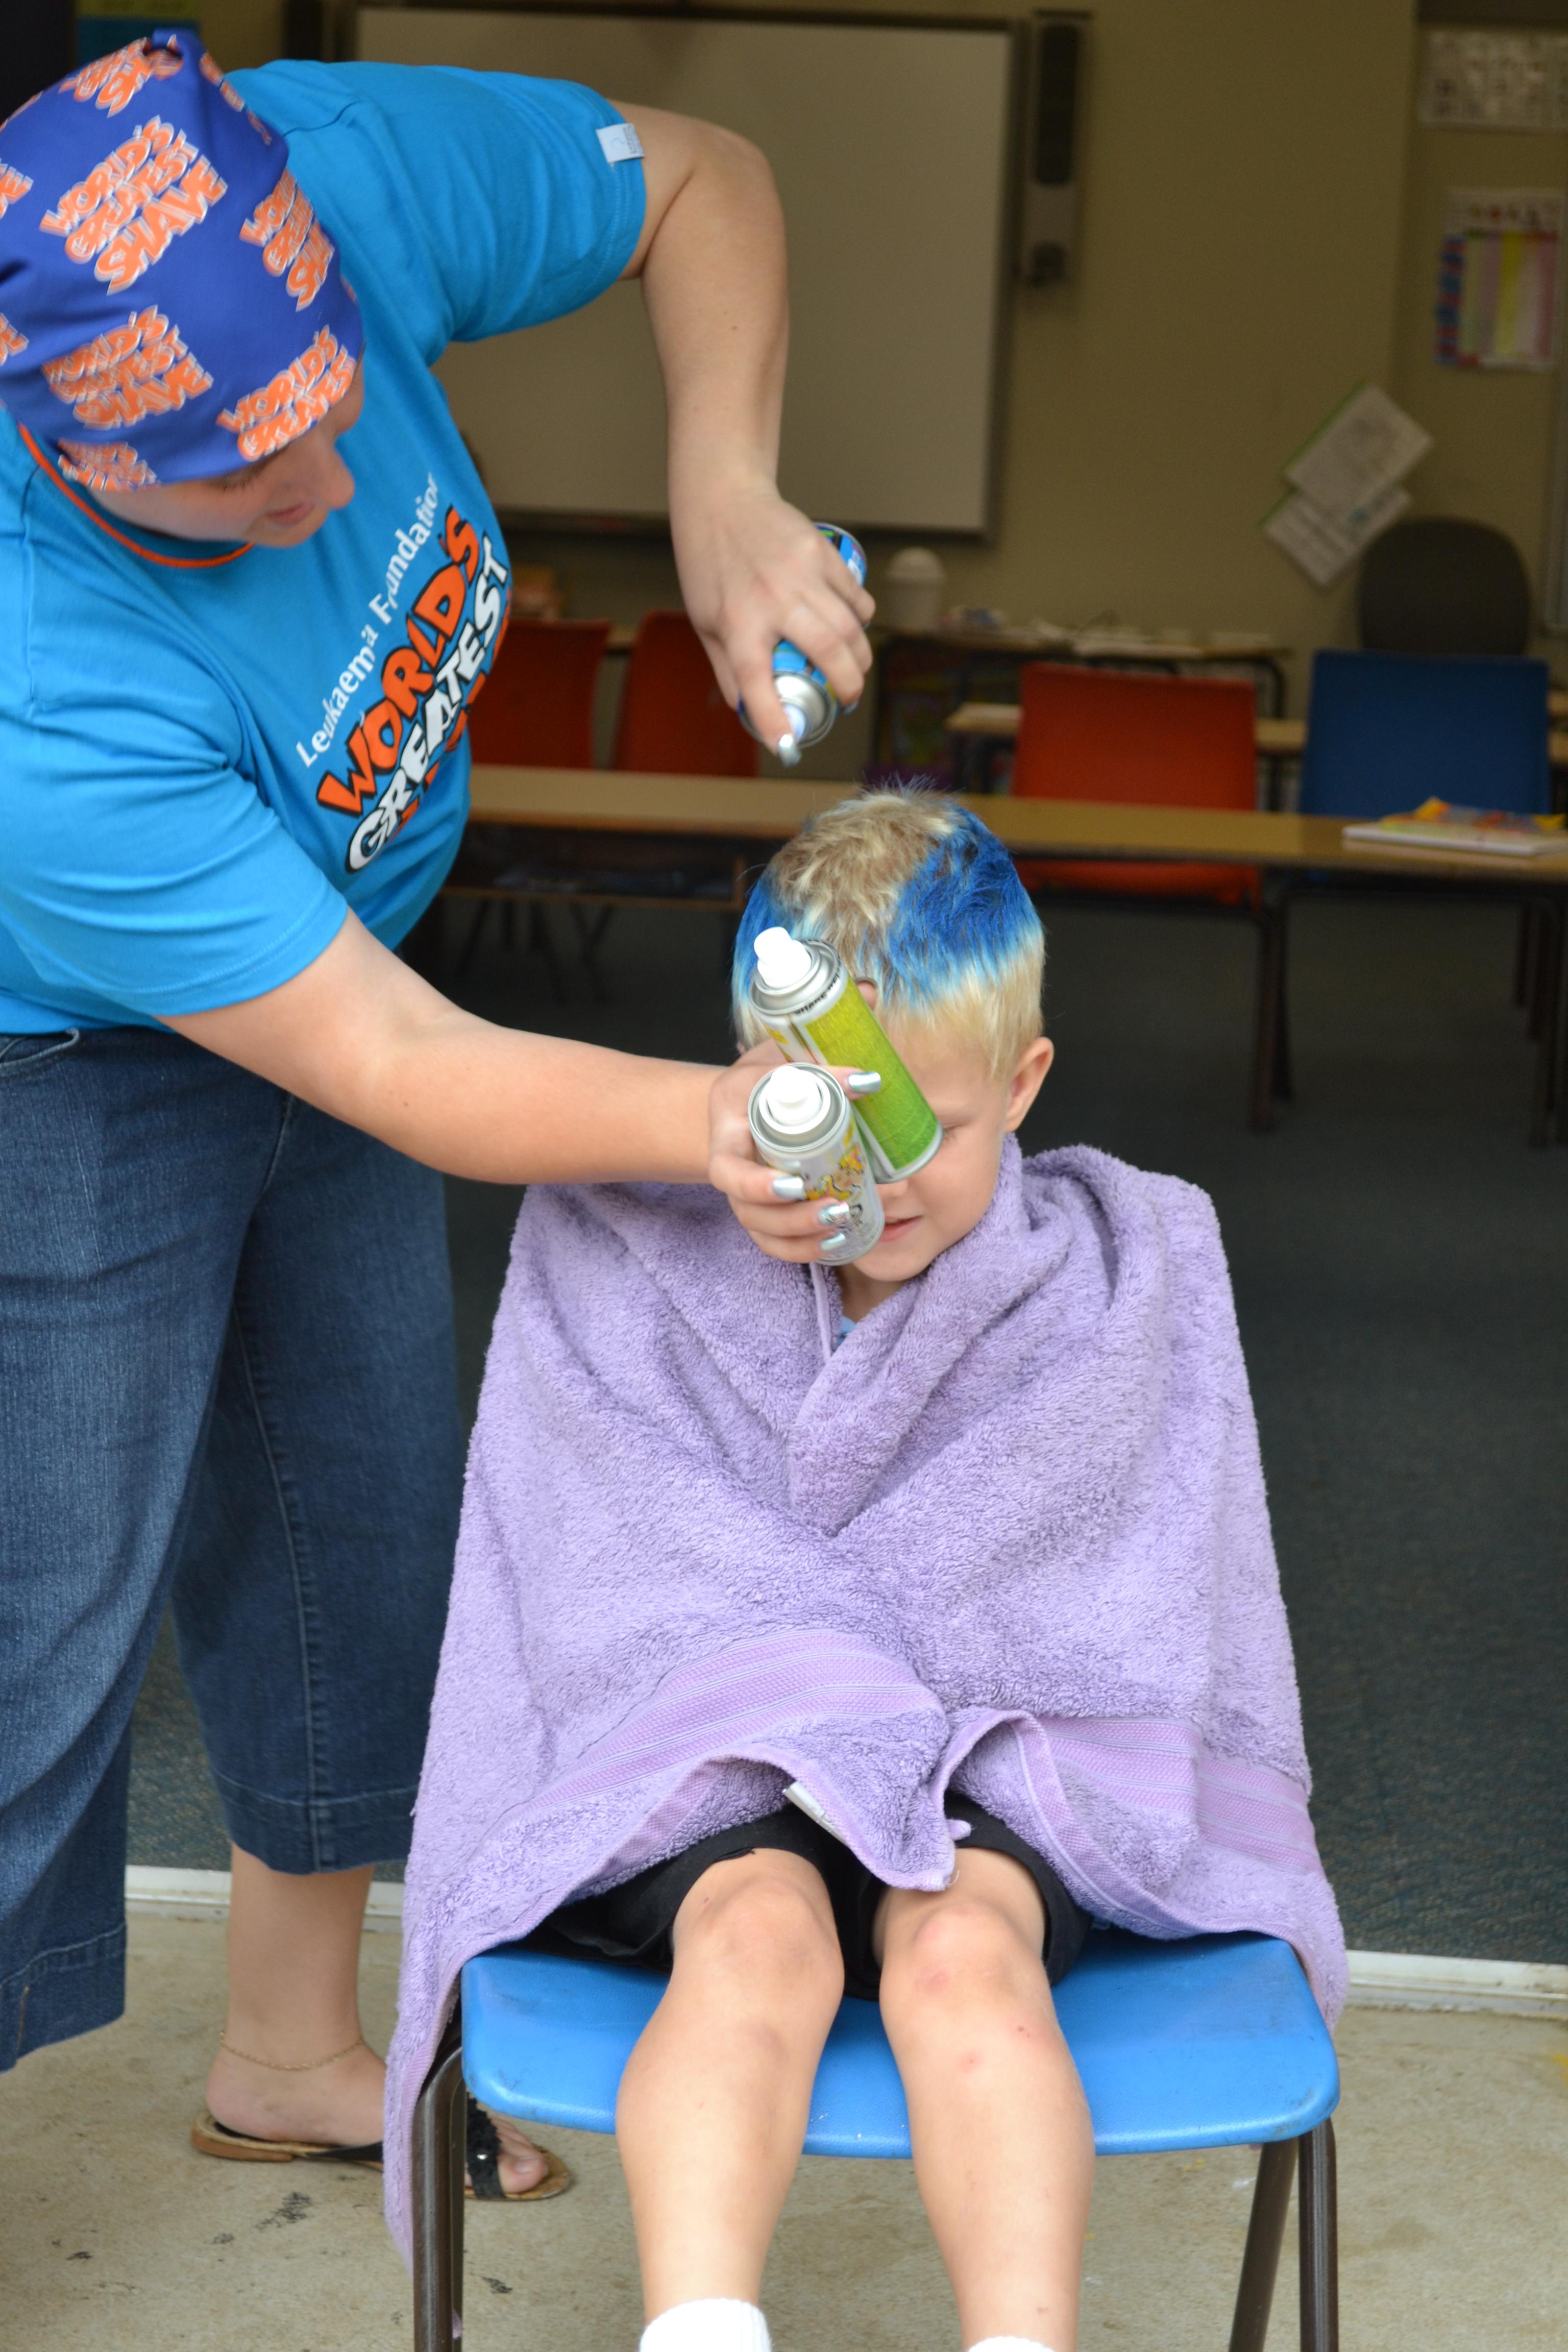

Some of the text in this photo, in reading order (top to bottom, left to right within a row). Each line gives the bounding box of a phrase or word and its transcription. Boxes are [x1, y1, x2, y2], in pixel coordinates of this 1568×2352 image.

[94, 154, 228, 296] SHAVE
[216, 324, 338, 435] WORLD'S
[237, 344, 356, 462] GREATES
[295, 624, 379, 768] Leukaema
[316, 504, 480, 817] WORLD'S
[344, 529, 509, 873] GREATEST
